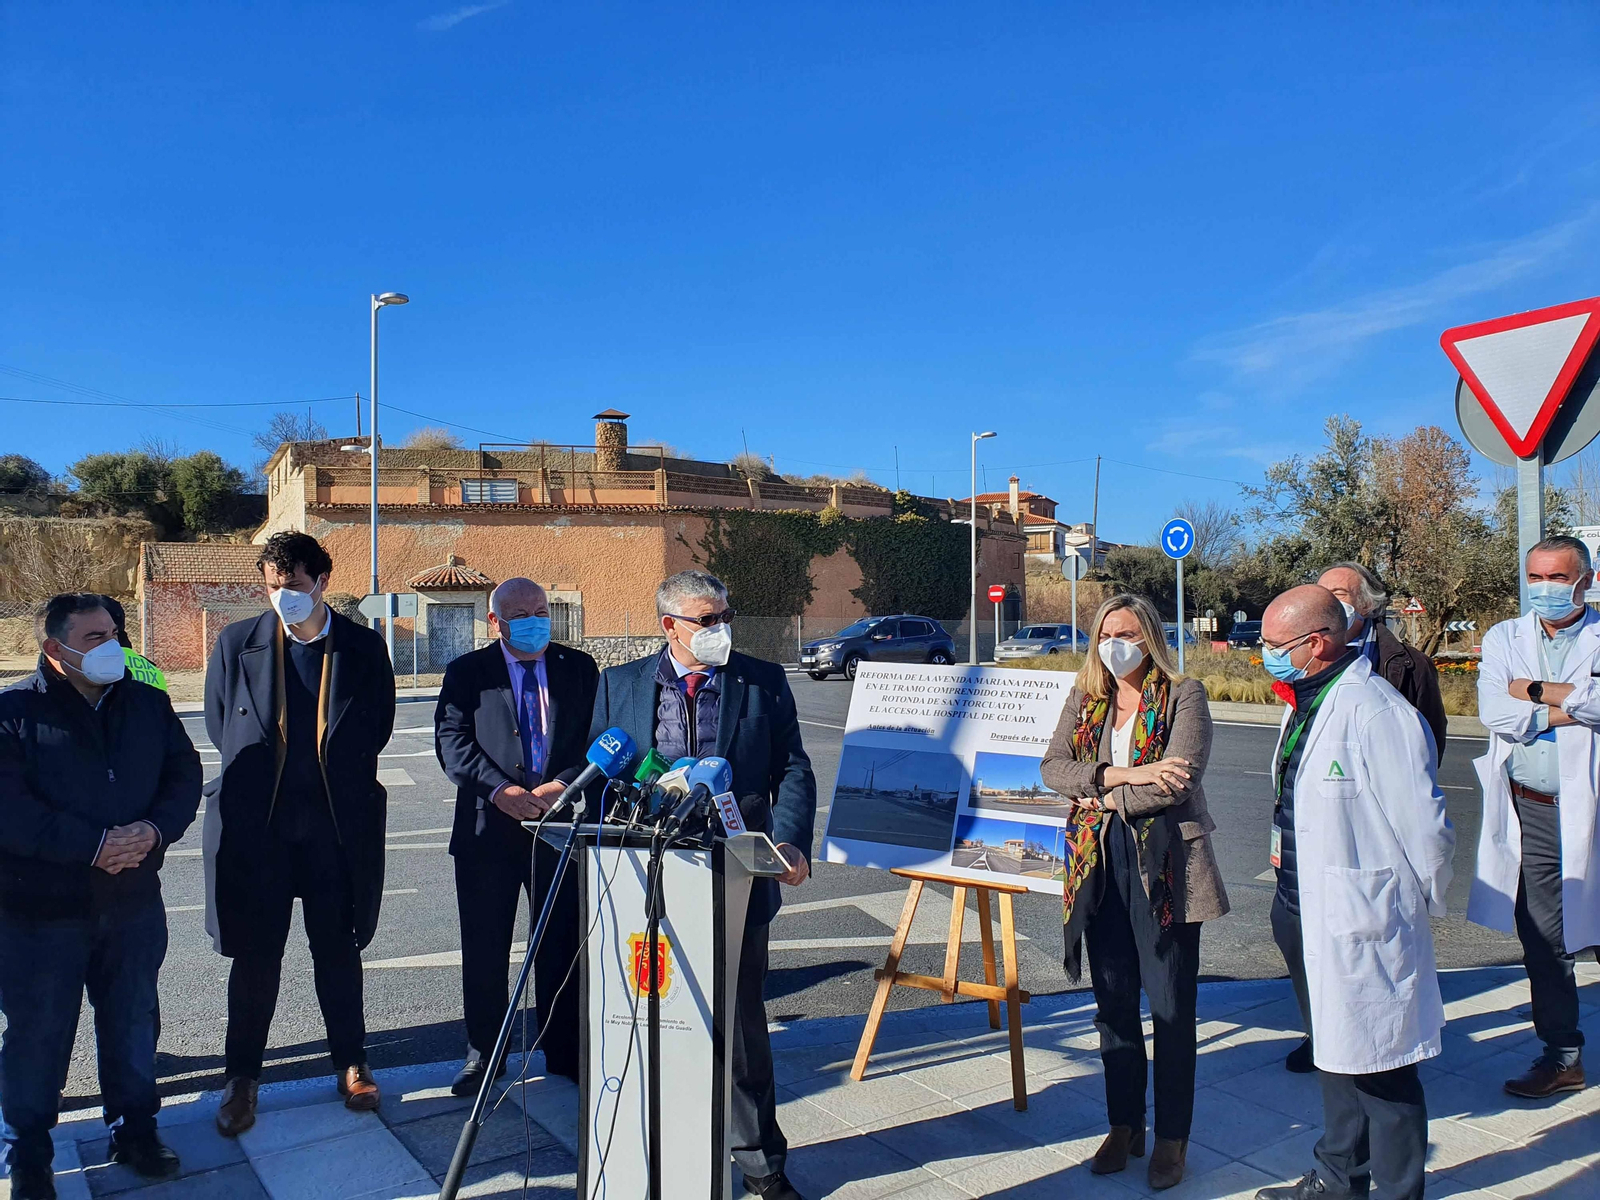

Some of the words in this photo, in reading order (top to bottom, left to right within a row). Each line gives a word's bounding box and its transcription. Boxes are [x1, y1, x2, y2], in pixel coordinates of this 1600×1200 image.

[128, 656, 155, 671] ICIA
[134, 670, 160, 685] DIX
[860, 671, 903, 680] REFORMA
[904, 673, 917, 681] DE
[918, 674, 930, 682] LA
[931, 675, 972, 684] AVENIDA
[974, 677, 1020, 687] MARIANA
[1022, 680, 1060, 689] PINEDA
[879, 683, 890, 691] EL
[892, 684, 926, 693] TRAMO
[927, 686, 998, 697] COMPRENDIDO
[1000, 690, 1034, 699] ENTRE
[1035, 692, 1049, 701] LA
[881, 695, 925, 704] ROTONDA
[926, 697, 940, 705] DE
[941, 698, 960, 706] SAN
[962, 699, 1015, 710] TORCUATO
[1018, 703, 1025, 711] Y
[869, 705, 880, 713] EL
[881, 706, 918, 716] ACCESO
[919, 708, 931, 716] AL
[933, 709, 979, 719] HOSPITAL
[981, 712, 996, 720] DE
[997, 713, 1037, 723] GUADIX
[903, 726, 935, 734] actuación
[990, 732, 1019, 741] Después
